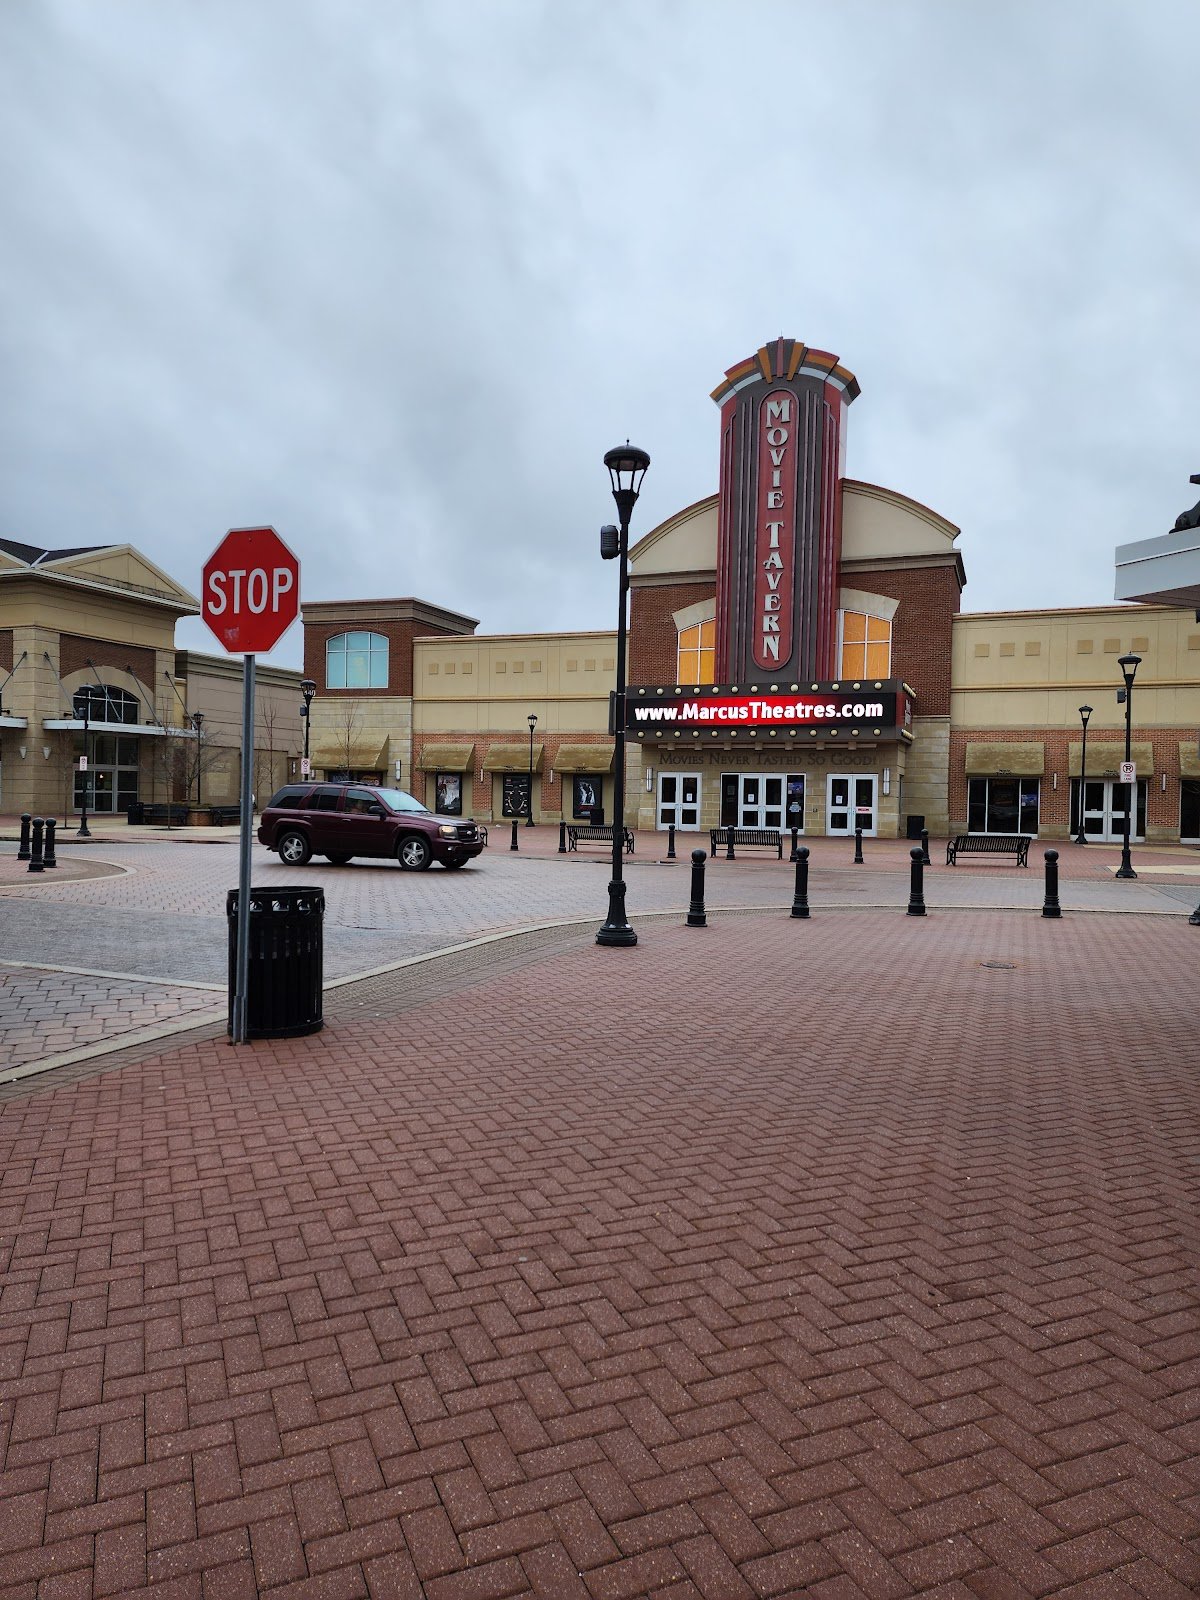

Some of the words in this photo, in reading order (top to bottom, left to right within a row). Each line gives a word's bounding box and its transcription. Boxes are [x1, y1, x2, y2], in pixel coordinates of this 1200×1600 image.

[765, 399, 791, 511] MOVIE
[207, 567, 293, 616] STOP
[762, 520, 784, 661] TAVERN
[634, 701, 884, 721] www.MarcusTheatres.com
